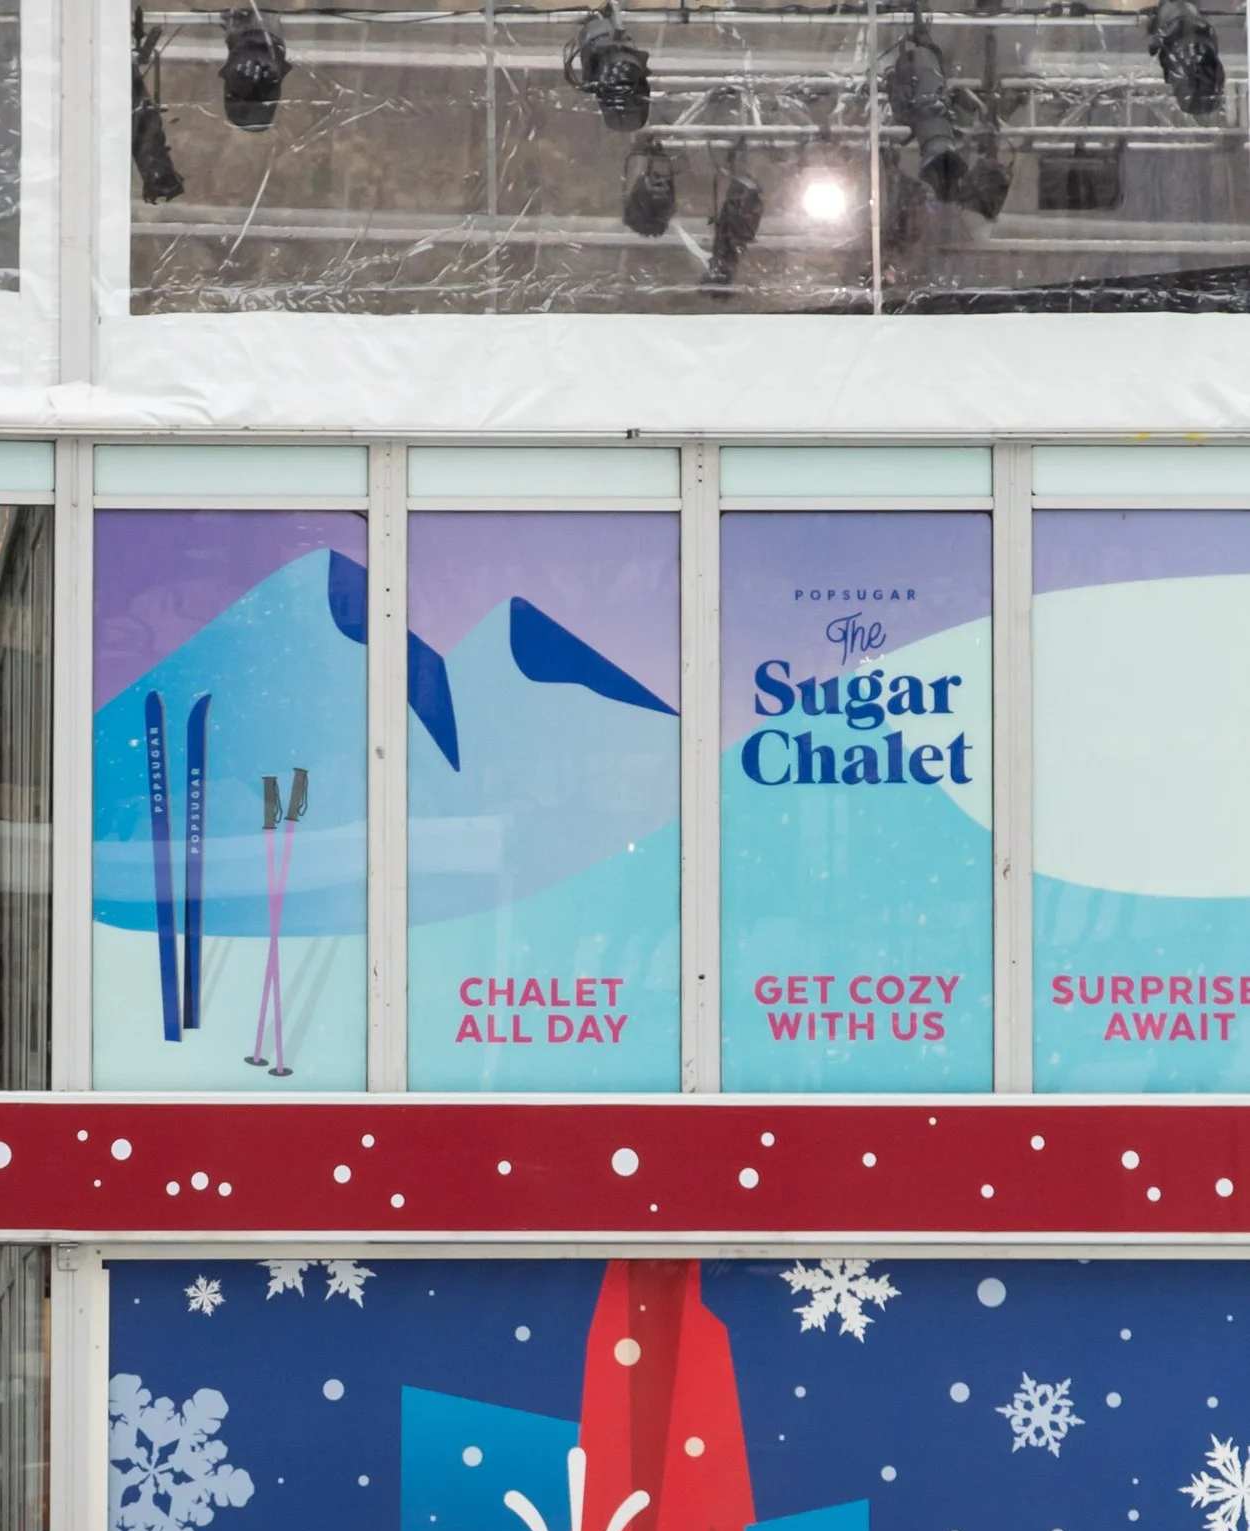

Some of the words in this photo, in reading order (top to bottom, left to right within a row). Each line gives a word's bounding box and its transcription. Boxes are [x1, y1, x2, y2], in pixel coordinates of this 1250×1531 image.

[795, 589, 917, 601] POPSUGAR
[826, 612, 887, 666] The
[755, 660, 962, 730] Sugar
[150, 726, 163, 813] POPSUGAR
[741, 729, 973, 786] Chalet
[190, 767, 201, 854] POPSUGAR
[460, 977, 623, 1007] CHALET
[755, 975, 834, 1005] GET
[849, 975, 959, 1005] COZY
[456, 1014, 531, 1043] ALL
[548, 1014, 627, 1043] DAY
[768, 1012, 874, 1040] WITH
[892, 1012, 945, 1041] US
[1105, 1012, 1236, 1041] AWAIT
